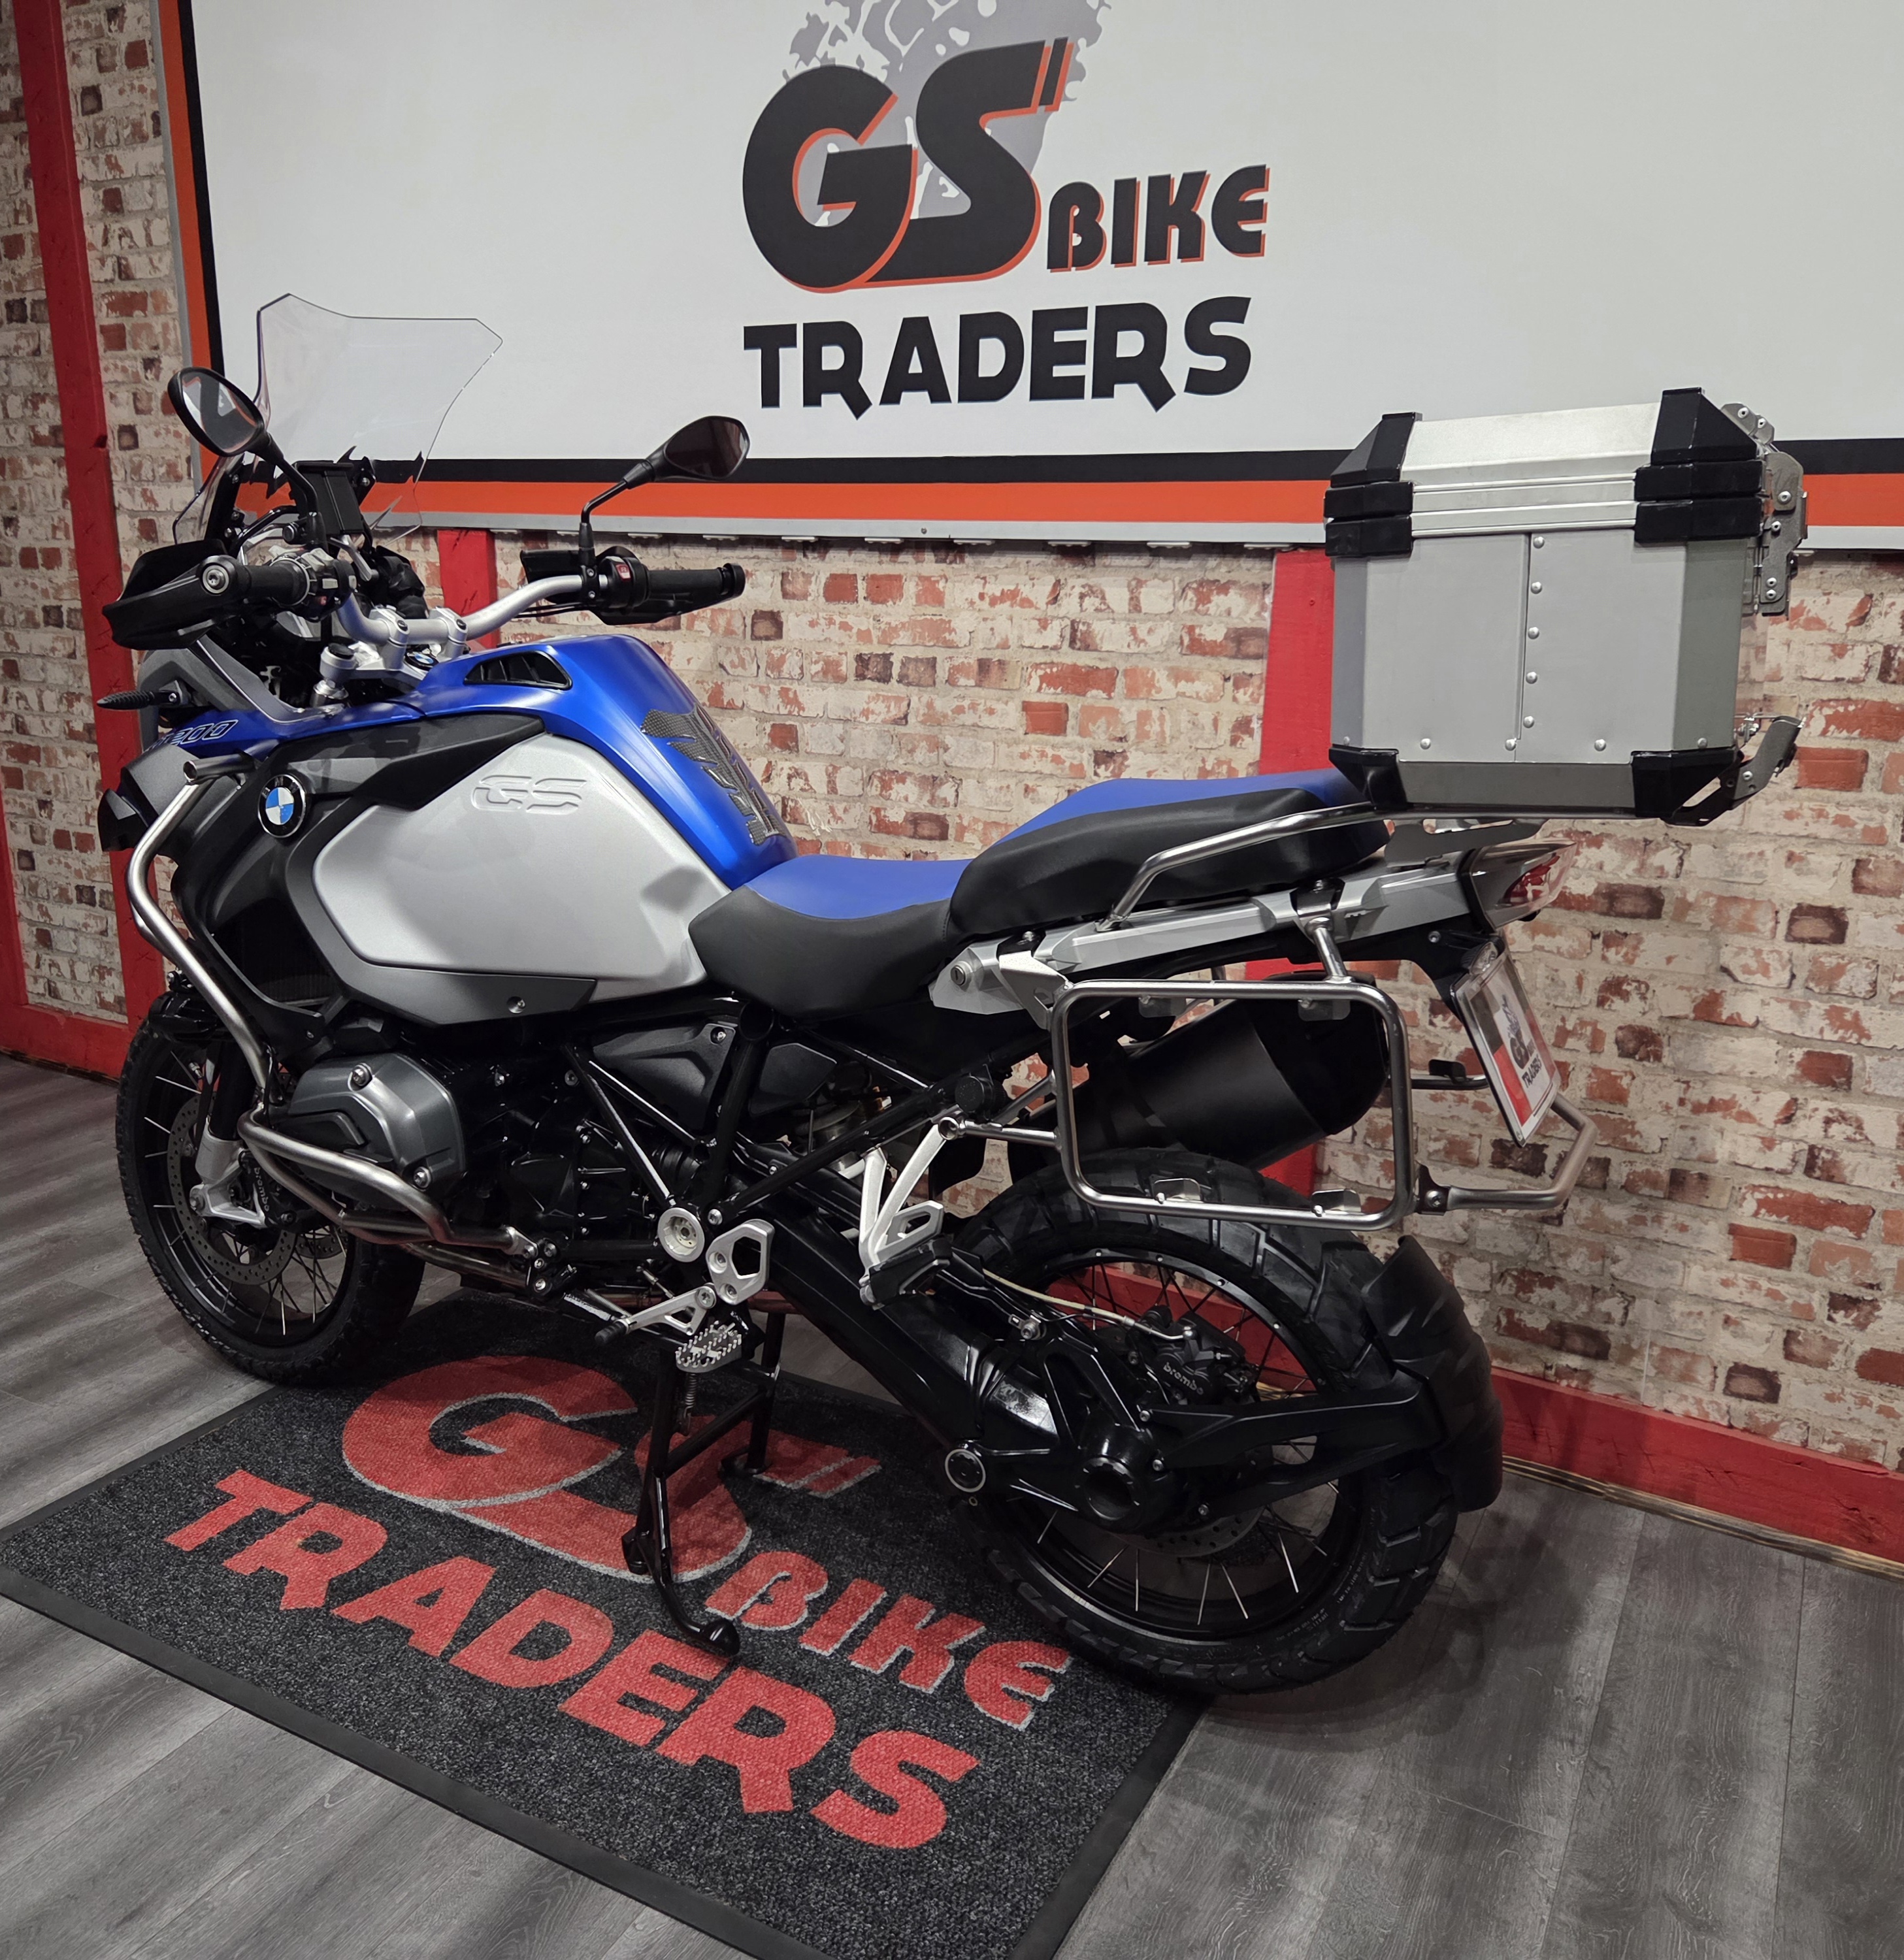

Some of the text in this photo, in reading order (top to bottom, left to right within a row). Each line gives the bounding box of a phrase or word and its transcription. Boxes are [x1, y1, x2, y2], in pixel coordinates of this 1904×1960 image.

[1046, 164, 1270, 273] BIKE
[743, 296, 1252, 421] TRADERS
[470, 774, 587, 815] GS
[254, 1167, 270, 1212] brembo
[1163, 1362, 1204, 1396] brembo
[162, 1468, 983, 1850] TRADERS
[704, 1550, 1072, 1731] BIKE
